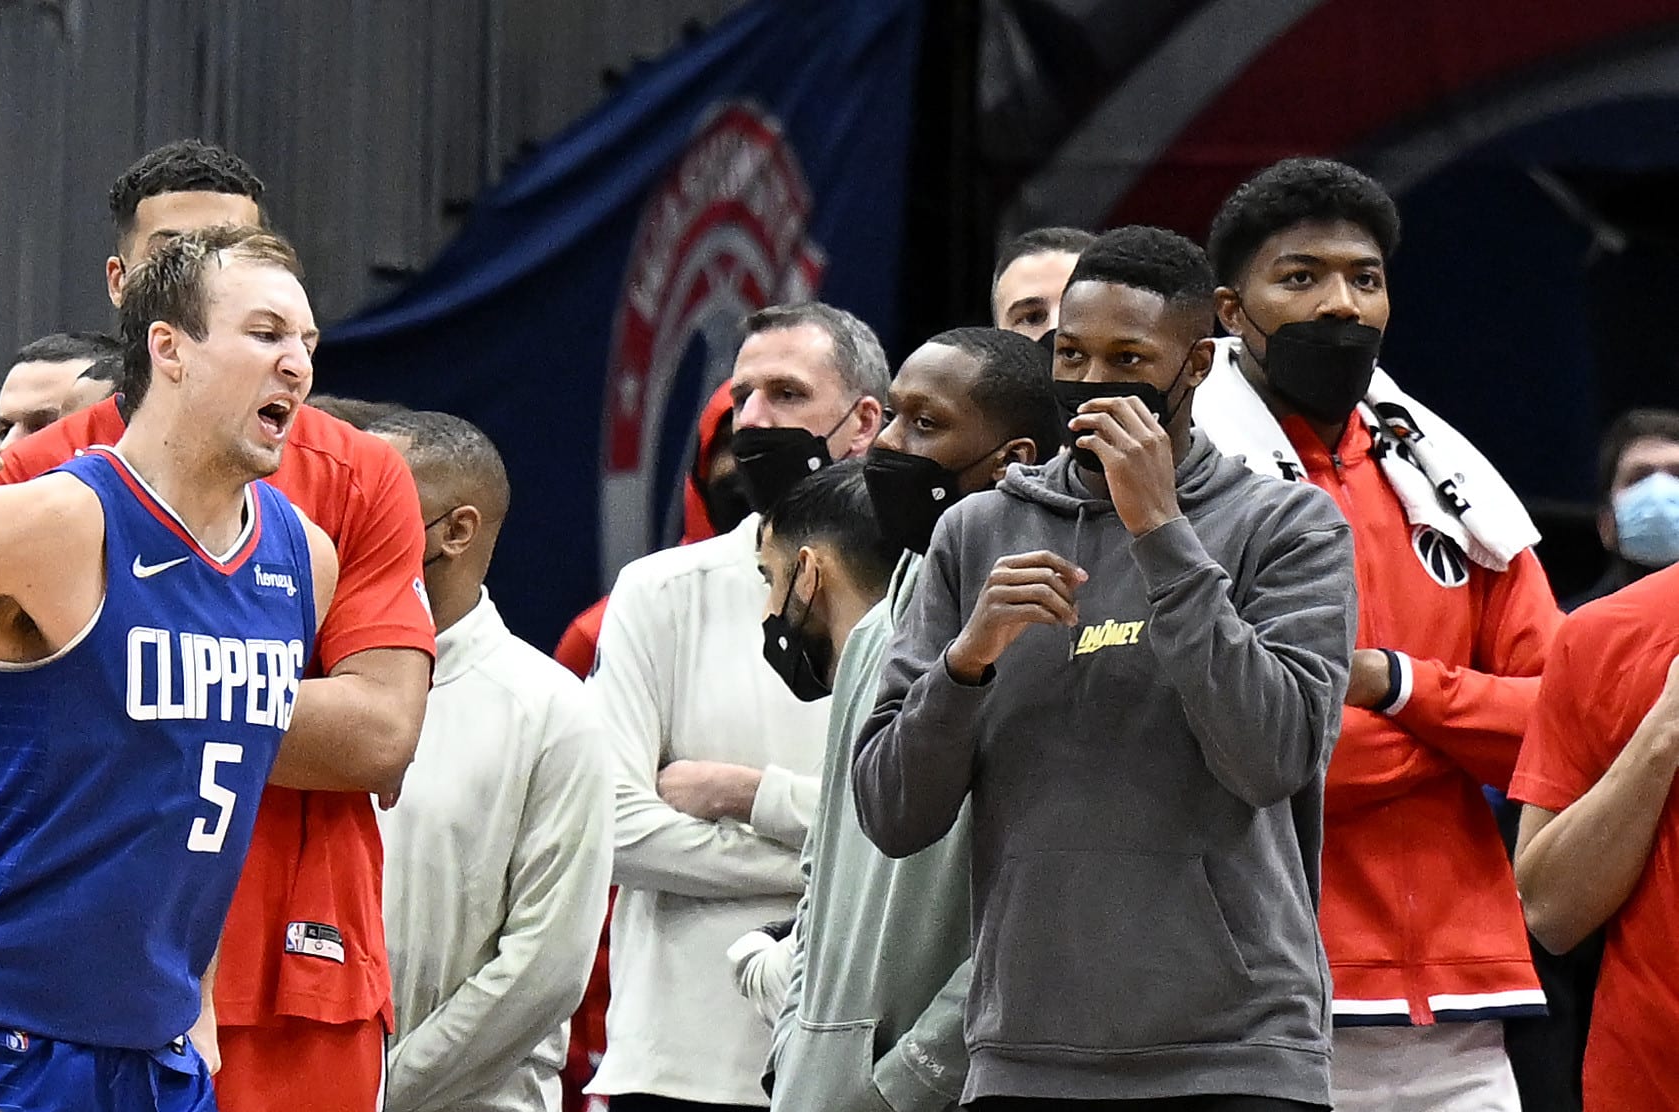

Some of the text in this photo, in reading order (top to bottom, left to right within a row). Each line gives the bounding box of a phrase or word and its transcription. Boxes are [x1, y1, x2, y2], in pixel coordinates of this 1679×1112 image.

[254, 563, 297, 597] honey
[126, 625, 304, 731] CLIPPERS
[186, 742, 244, 853] 5
